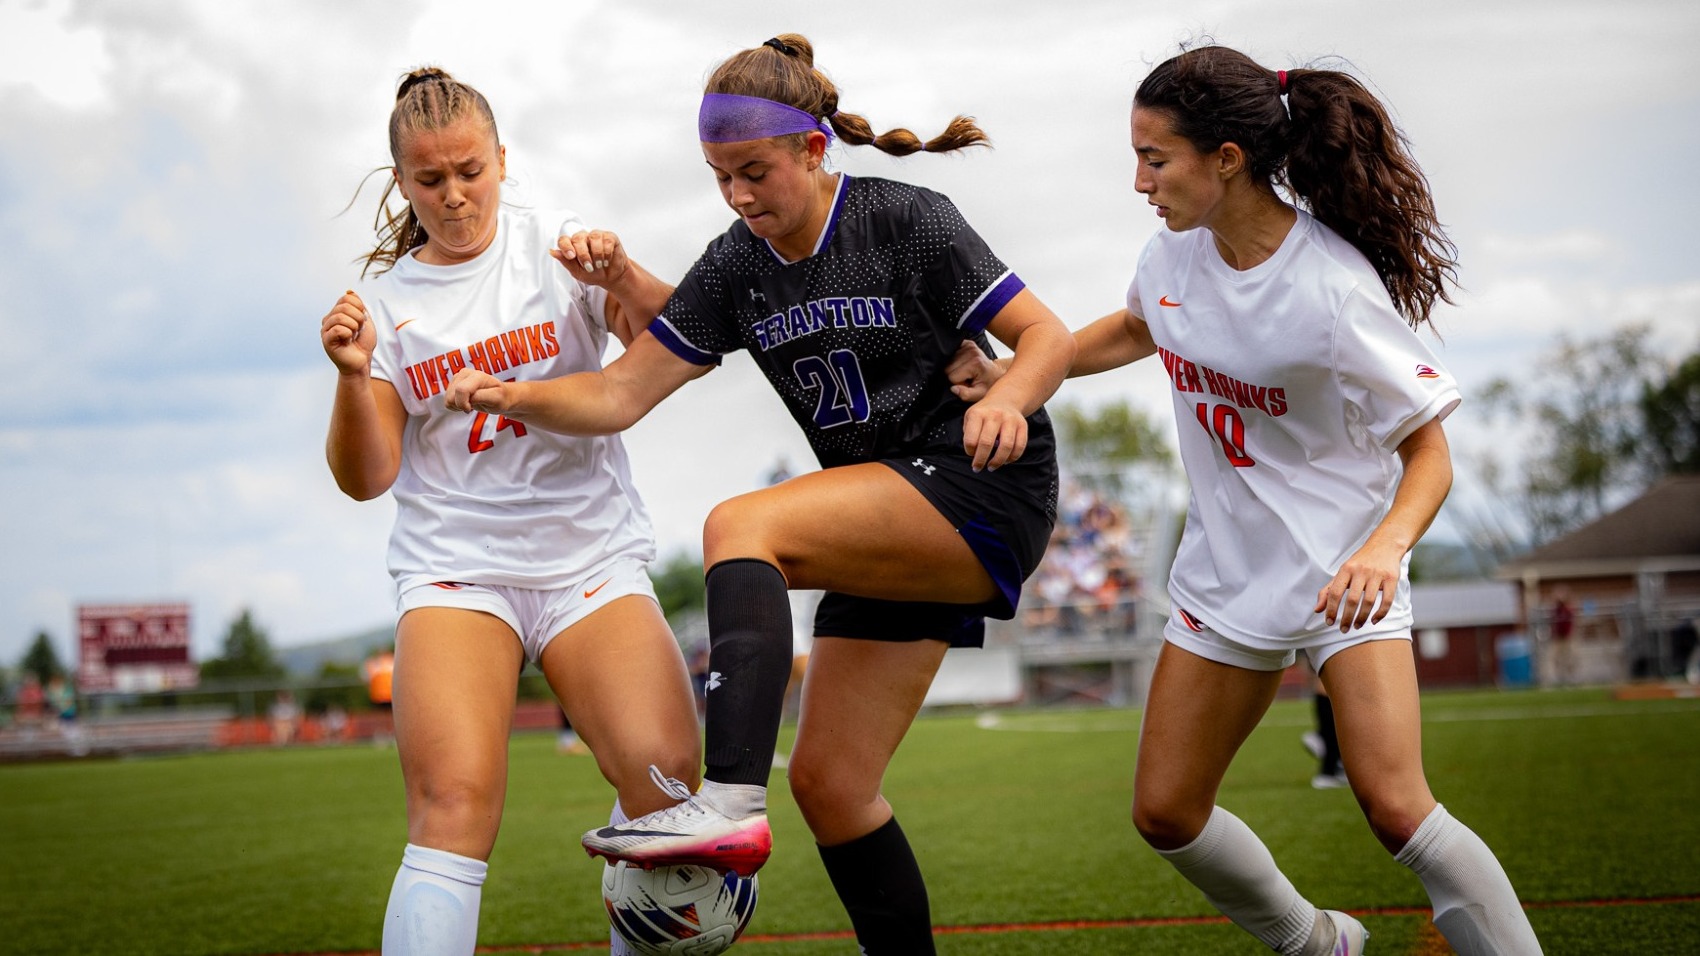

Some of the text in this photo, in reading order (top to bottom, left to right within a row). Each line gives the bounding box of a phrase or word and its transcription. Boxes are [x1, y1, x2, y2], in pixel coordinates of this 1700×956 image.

[468, 321, 560, 375] HAWKS
[1158, 346, 1288, 417] VER HAWKS
[793, 349, 870, 429] 20
[1196, 403, 1256, 468] 10
